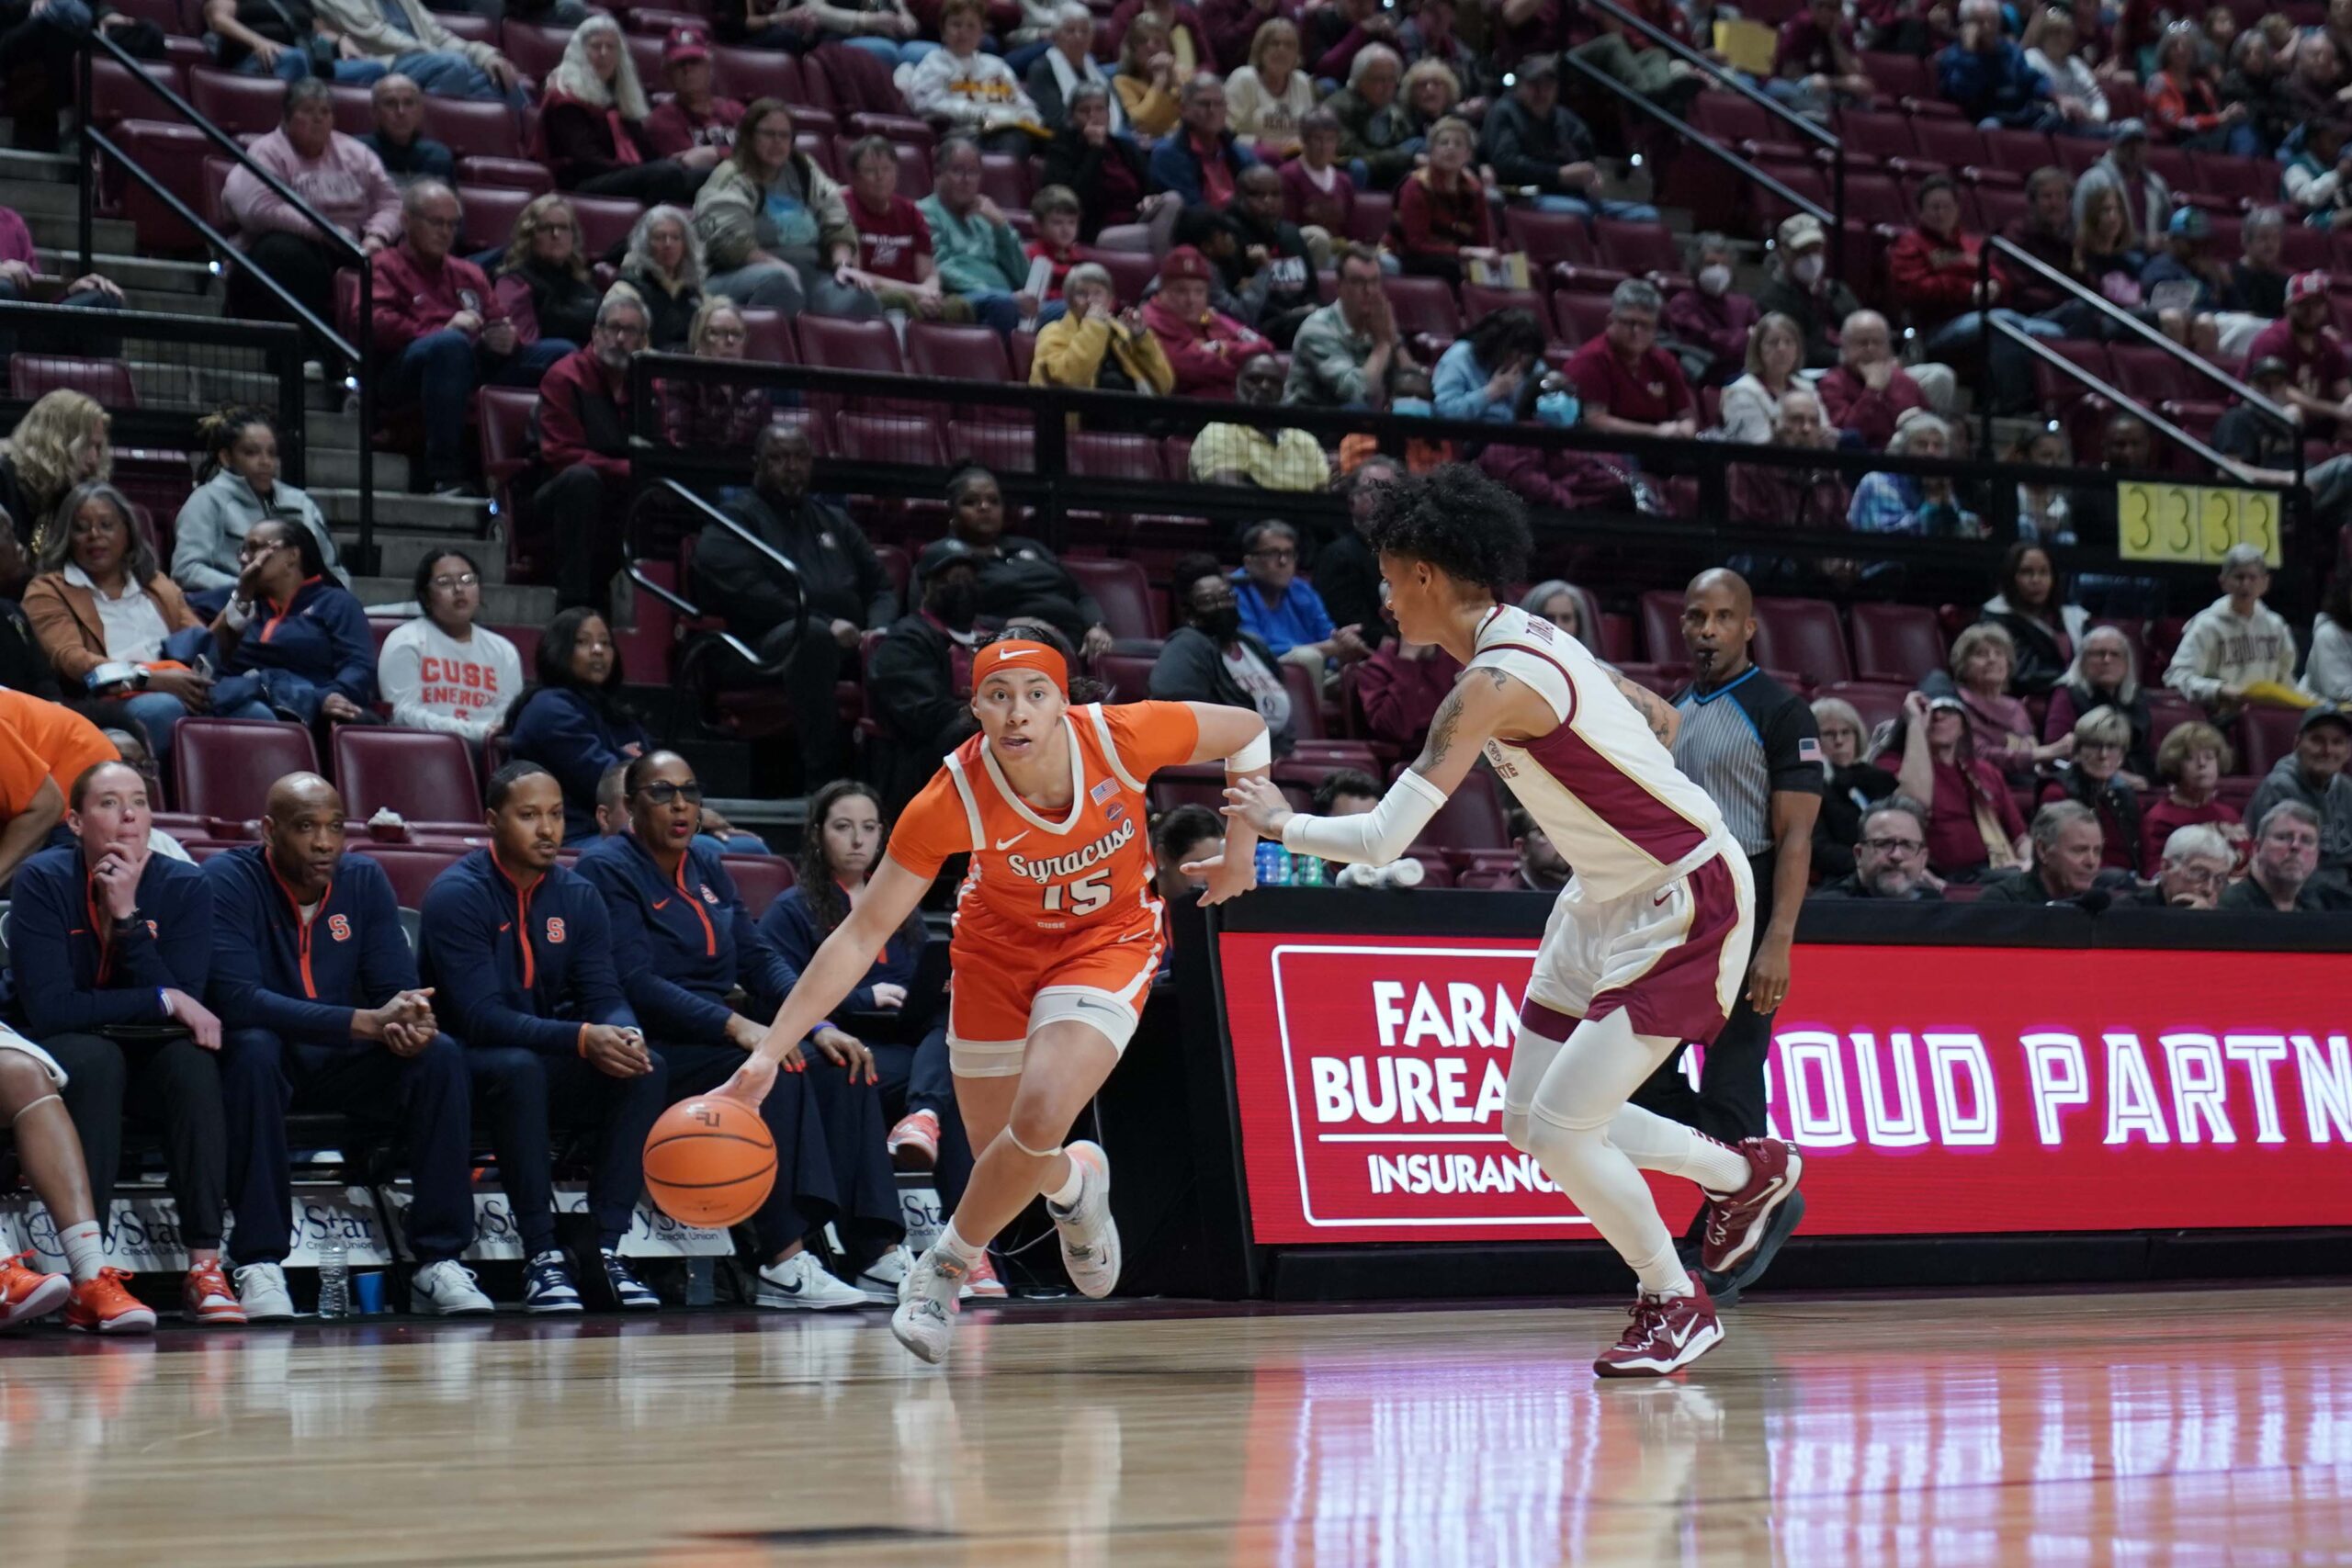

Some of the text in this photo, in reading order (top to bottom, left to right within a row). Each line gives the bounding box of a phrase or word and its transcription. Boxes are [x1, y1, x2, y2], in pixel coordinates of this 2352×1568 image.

[421, 656, 498, 693] CUSE
[421, 686, 494, 709] ENERGY
[1008, 818, 1136, 885] Syracuse
[1043, 868, 1112, 916] 15
[328, 913, 351, 942] S
[547, 917, 566, 943] S
[1310, 1055, 1508, 1124] BUREA
[1678, 1031, 1998, 1147] OUD
[1367, 1154, 1564, 1194] INSURANC
[289, 1204, 374, 1250] yStar
